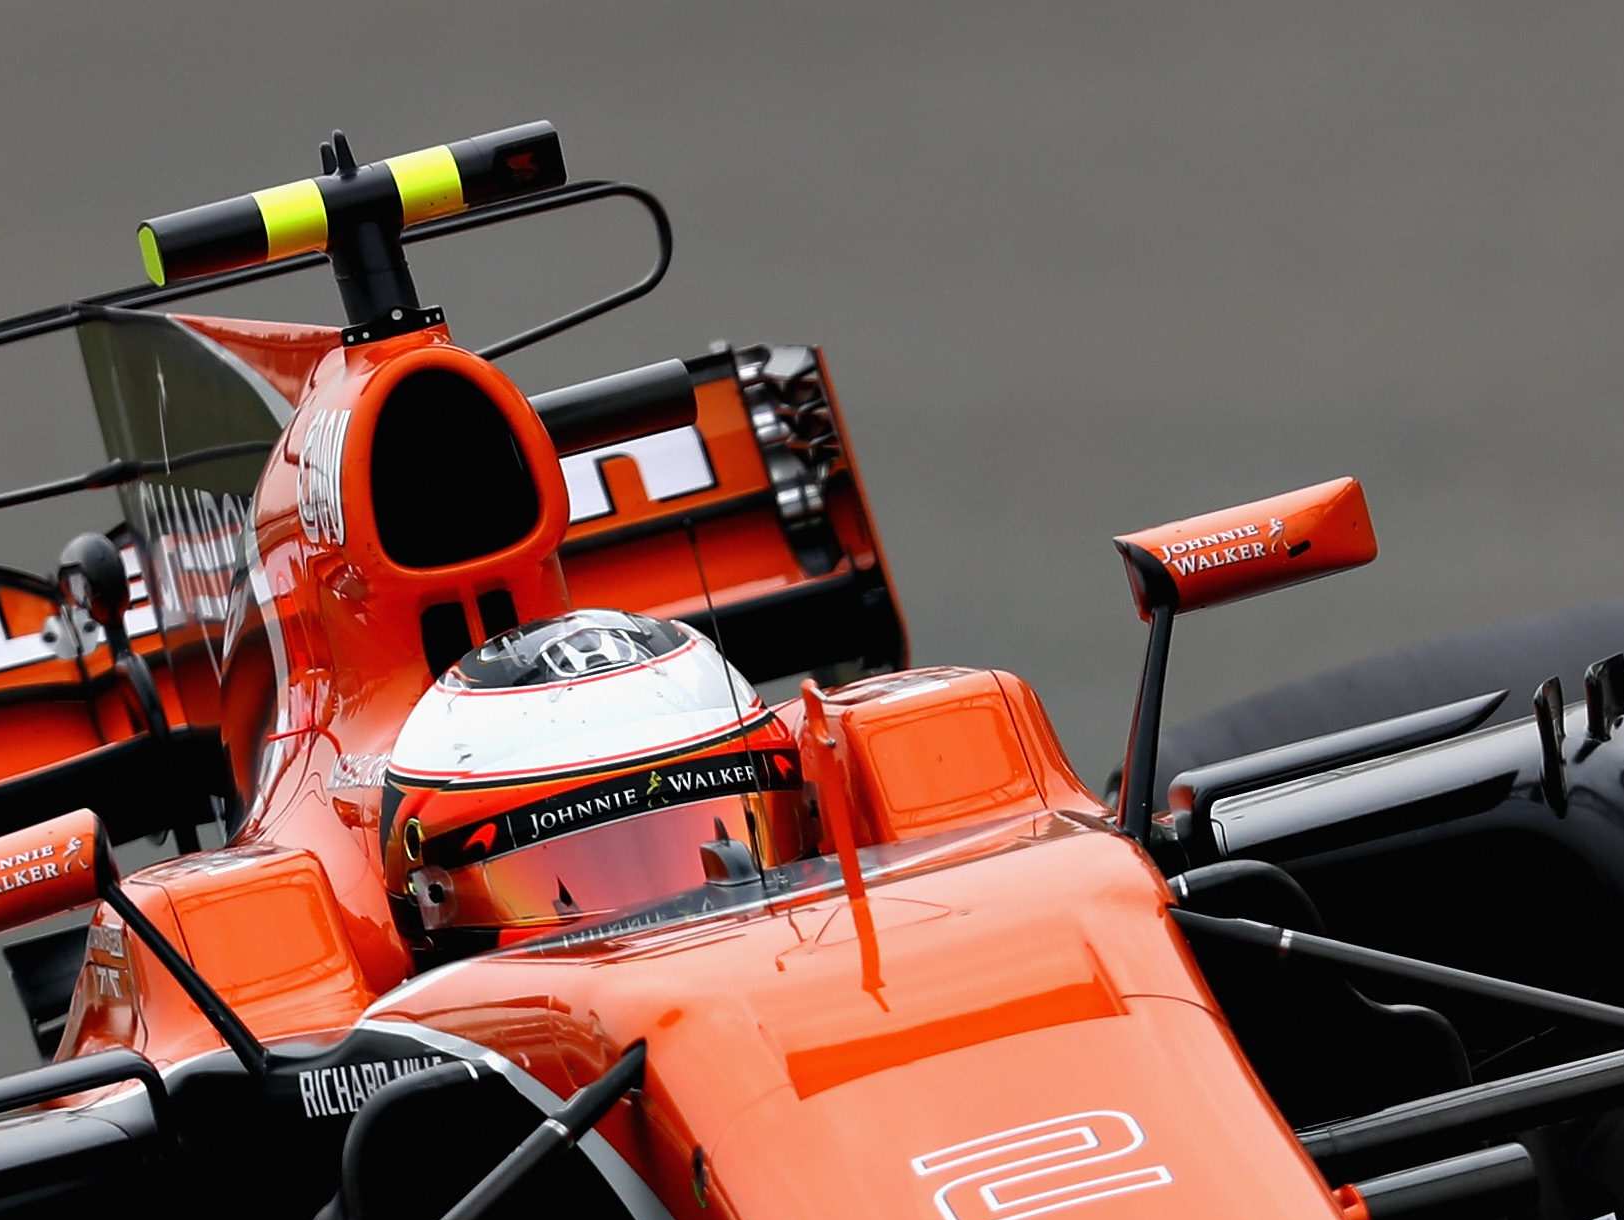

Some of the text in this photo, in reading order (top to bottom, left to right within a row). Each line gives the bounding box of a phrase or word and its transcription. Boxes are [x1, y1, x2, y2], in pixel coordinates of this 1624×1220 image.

[1159, 524, 1260, 564] JOHNNIE
[1171, 541, 1267, 576] WALKER
[530, 764, 757, 839] JOHNNIE WALKER
